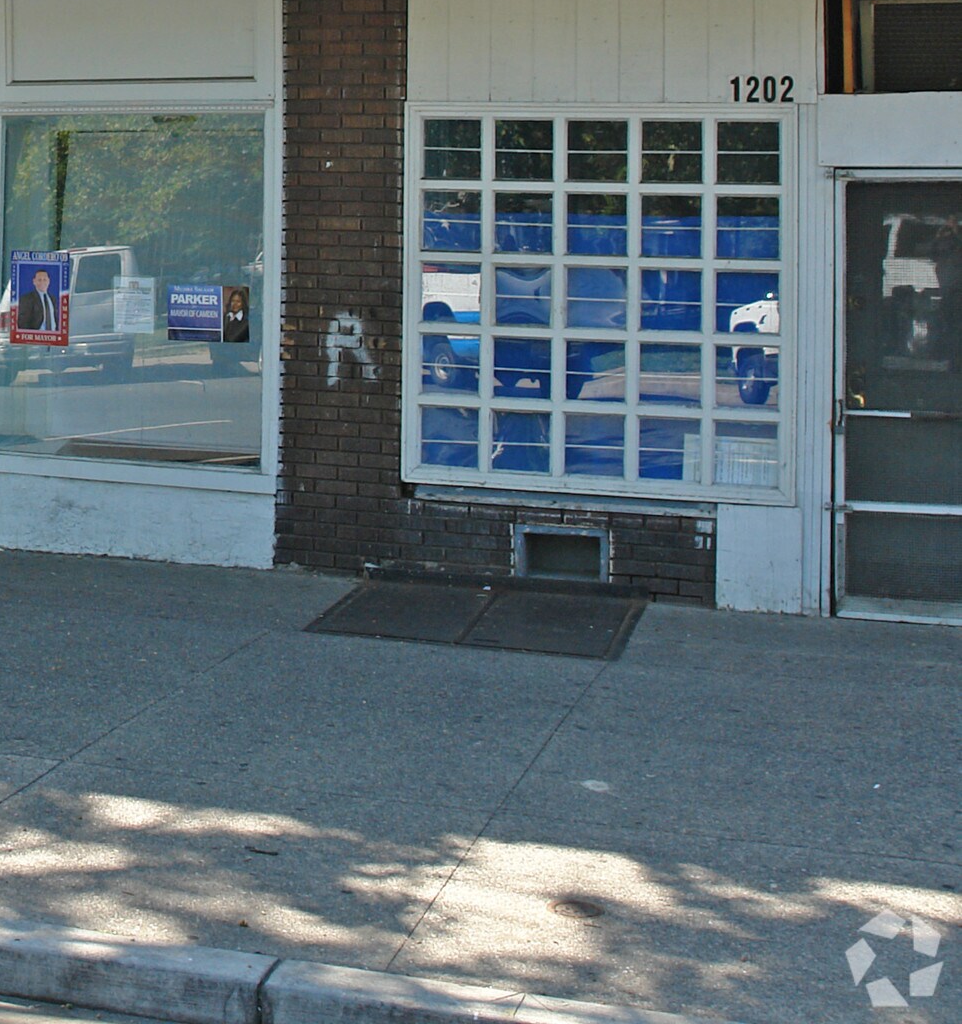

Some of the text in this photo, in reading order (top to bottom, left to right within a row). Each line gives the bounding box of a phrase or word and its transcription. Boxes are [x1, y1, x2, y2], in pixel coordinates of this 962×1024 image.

[730, 75, 794, 103] 1202
[170, 293, 218, 305] PARKER
[170, 308, 218, 319] MAYOR OF CAMDEN
[34, 334, 57, 342] MAYOR
